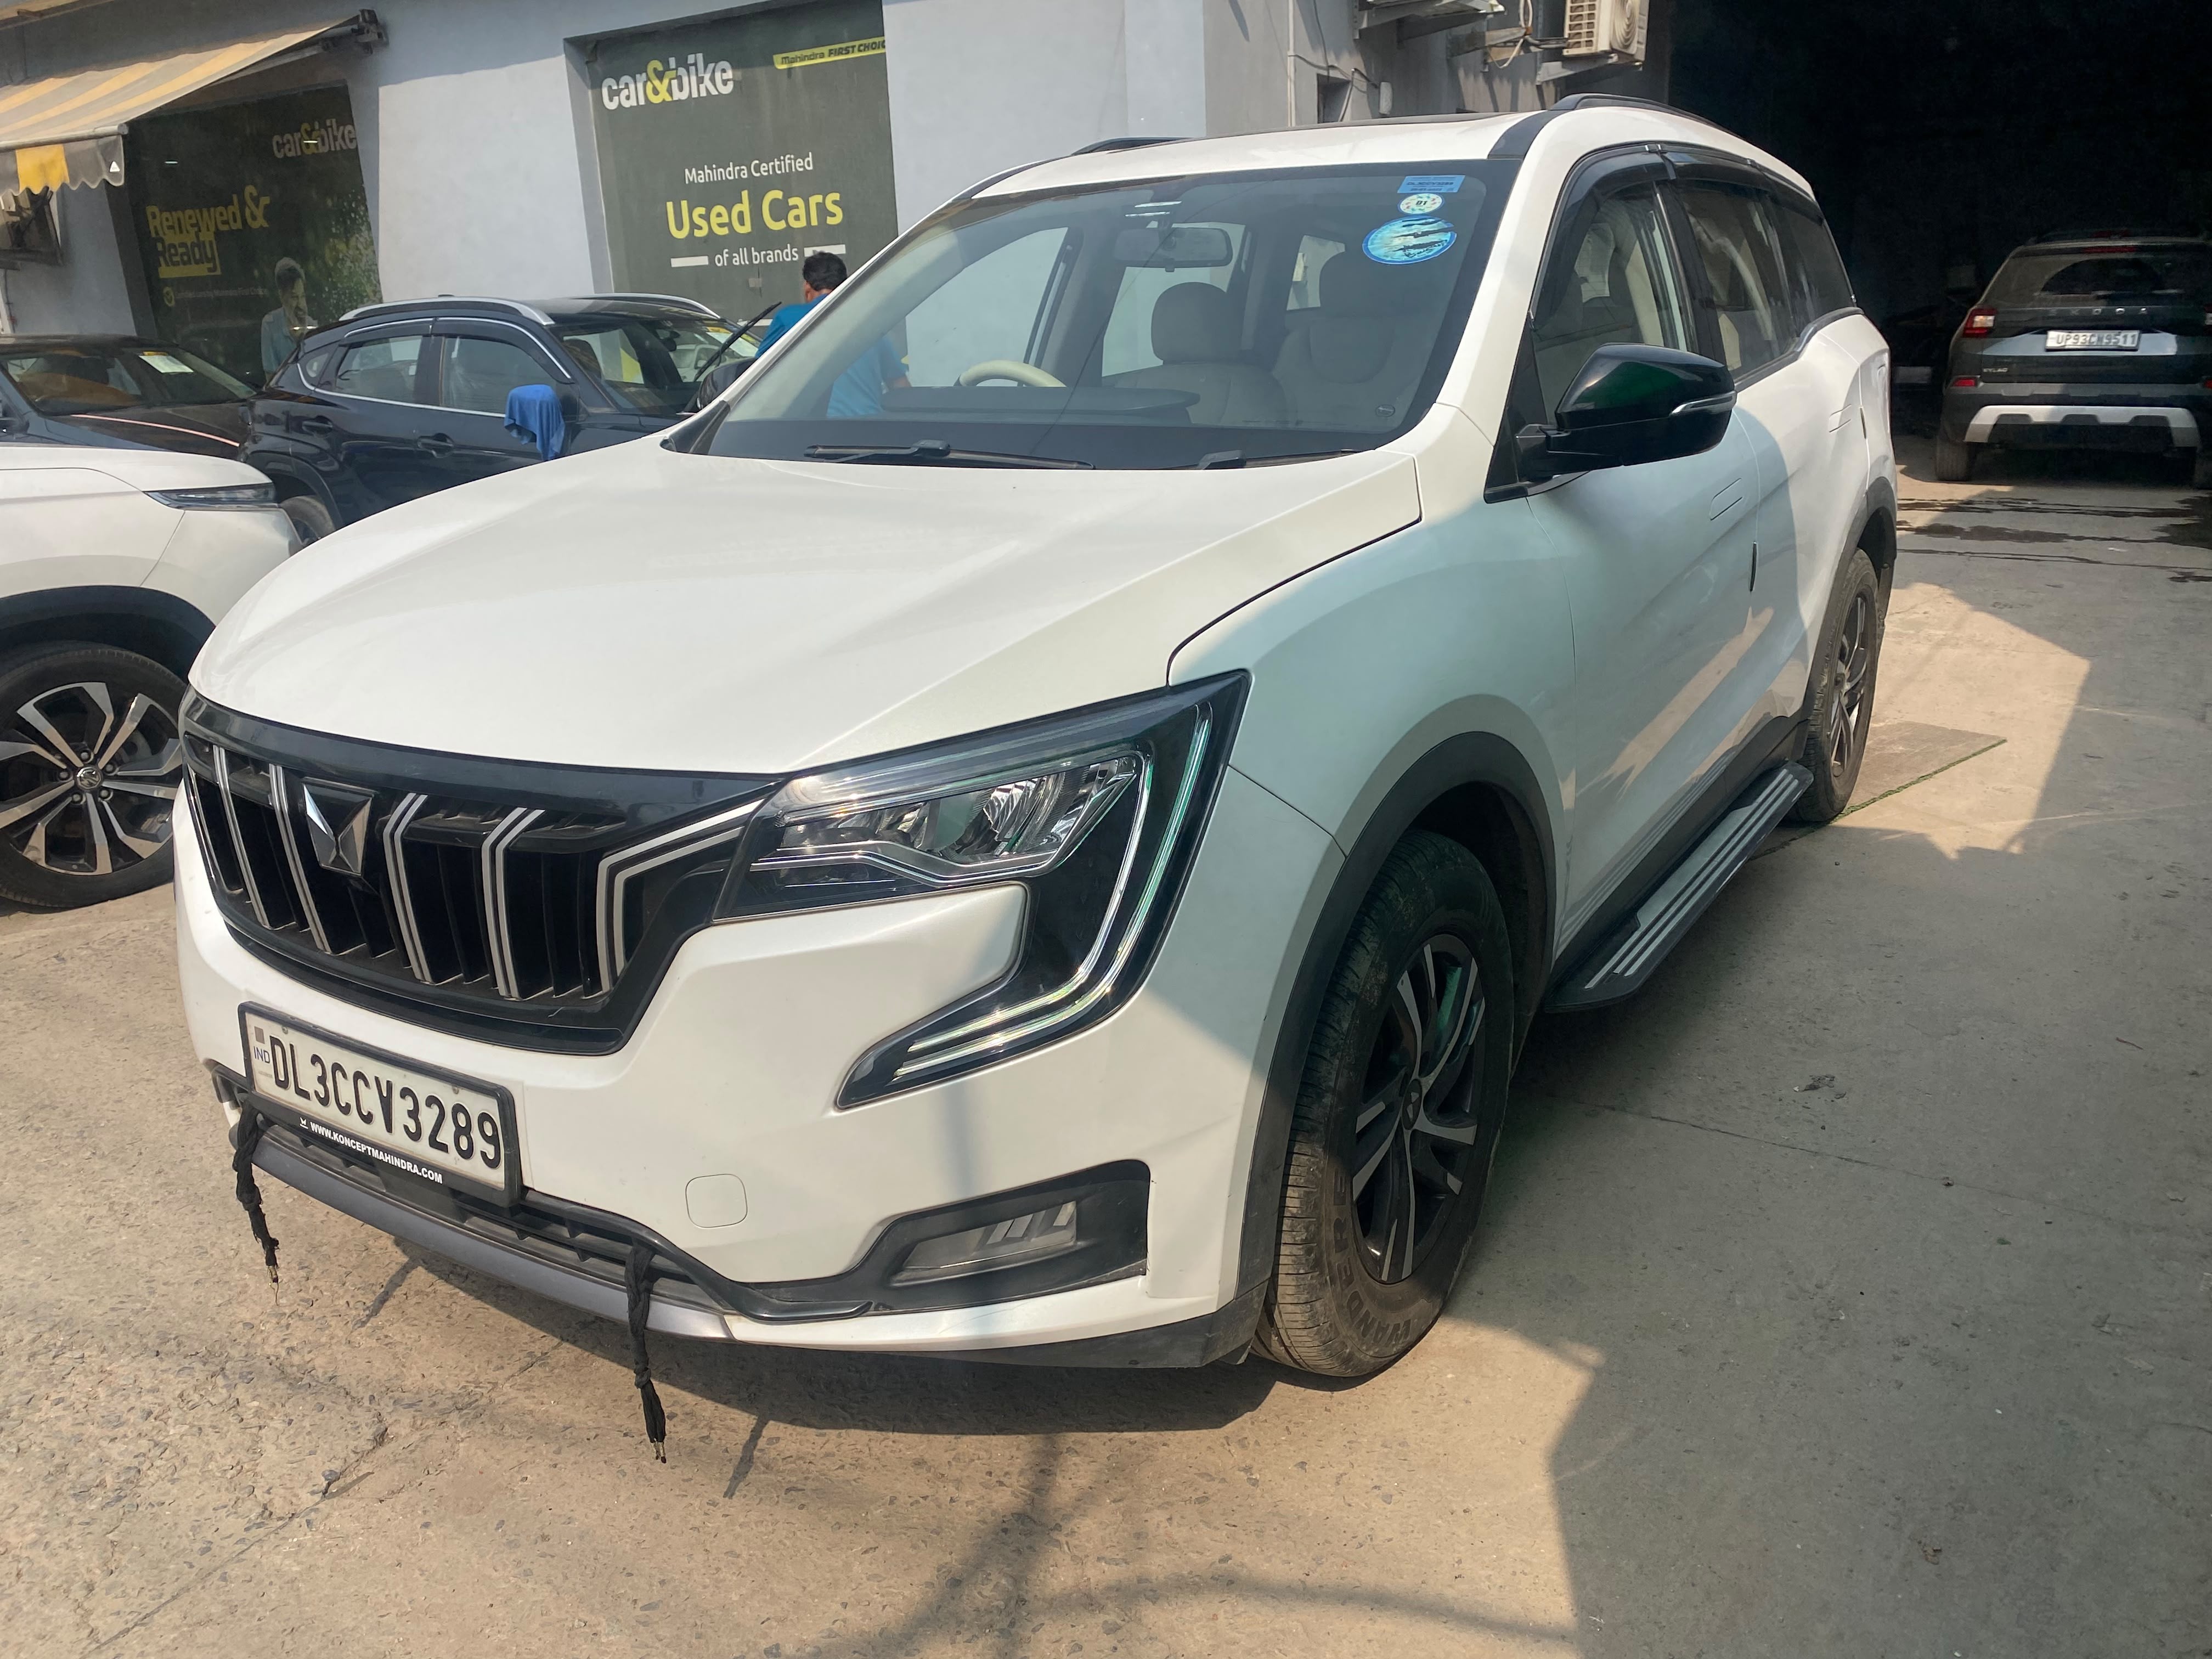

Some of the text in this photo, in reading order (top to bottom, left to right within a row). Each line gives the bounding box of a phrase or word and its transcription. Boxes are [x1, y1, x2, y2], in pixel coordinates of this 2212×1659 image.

[781, 52, 825, 64] Mahindra
[828, 44, 856, 57] FIRST
[602, 53, 733, 110] car&bike
[273, 119, 357, 159] car&bike
[685, 153, 813, 184] Mahindra Certified
[146, 185, 270, 240] Renewed &
[666, 189, 844, 239] Used Cars
[156, 232, 217, 273] Ready
[715, 246, 799, 267] of all brands
[253, 1046, 270, 1064] IND
[269, 1035, 501, 1169] DL3CCV3289
[310, 1121, 443, 1184] WWW.KONCEPTMAHINDRA.COM
